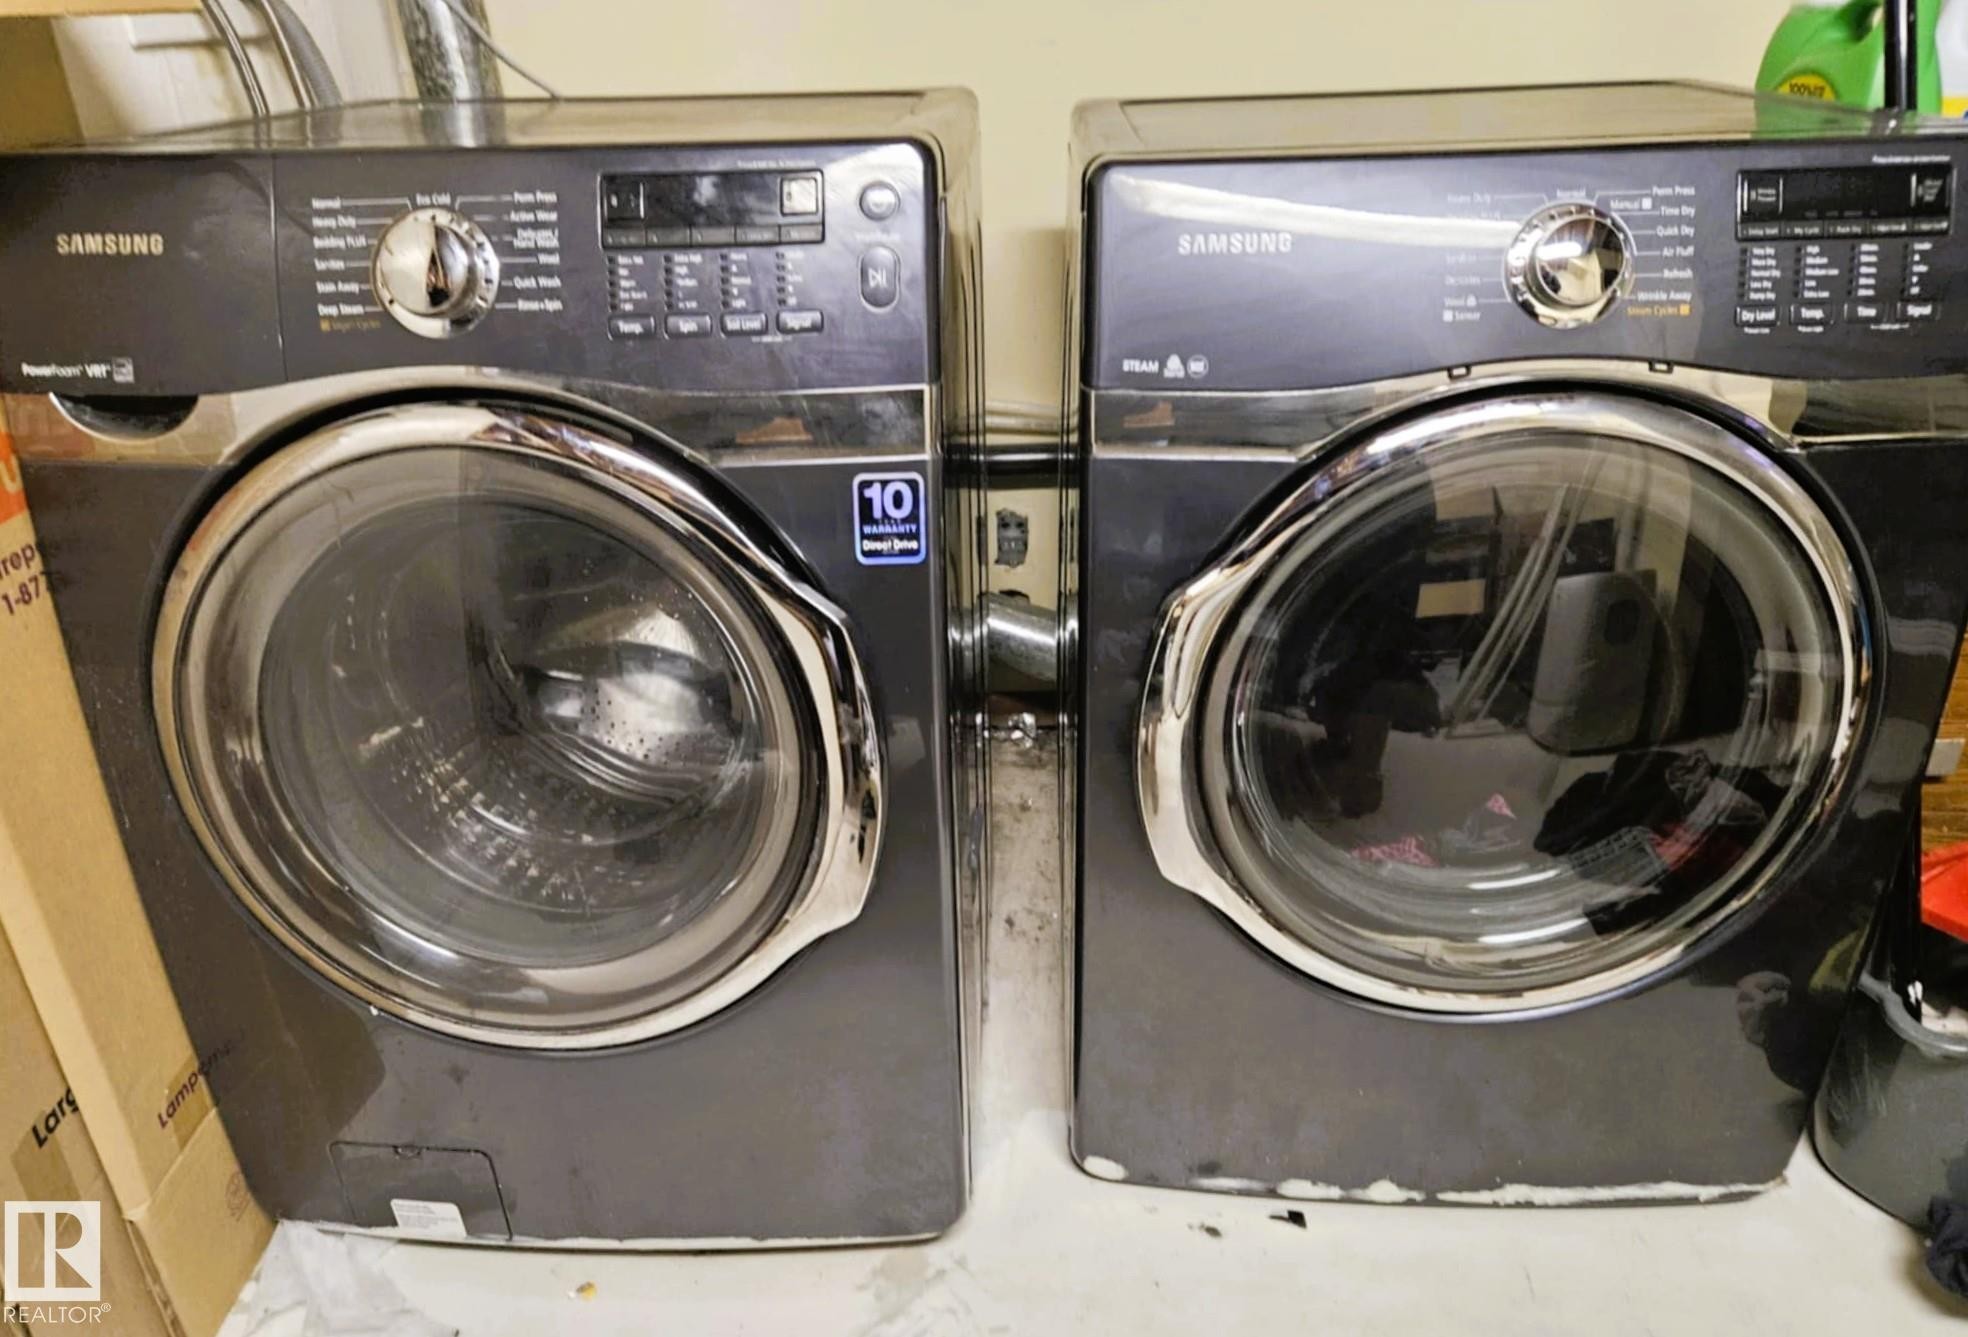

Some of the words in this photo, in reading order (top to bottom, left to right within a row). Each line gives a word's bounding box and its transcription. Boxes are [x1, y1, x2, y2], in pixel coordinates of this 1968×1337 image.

[1660, 206, 1681, 217] Time
[1681, 206, 1695, 218] Dry
[1656, 226, 1680, 238] Quick
[1680, 226, 1695, 238] Dry
[57, 233, 163, 255] SAMSUNG
[1178, 232, 1292, 256] SAMSUNG
[1668, 290, 1692, 302] Away
[1122, 359, 1160, 374] STEAM
[863, 481, 913, 520] 10
[862, 523, 917, 535] WARRANTY
[862, 539, 893, 551] Direct
[893, 538, 919, 551] Drive
